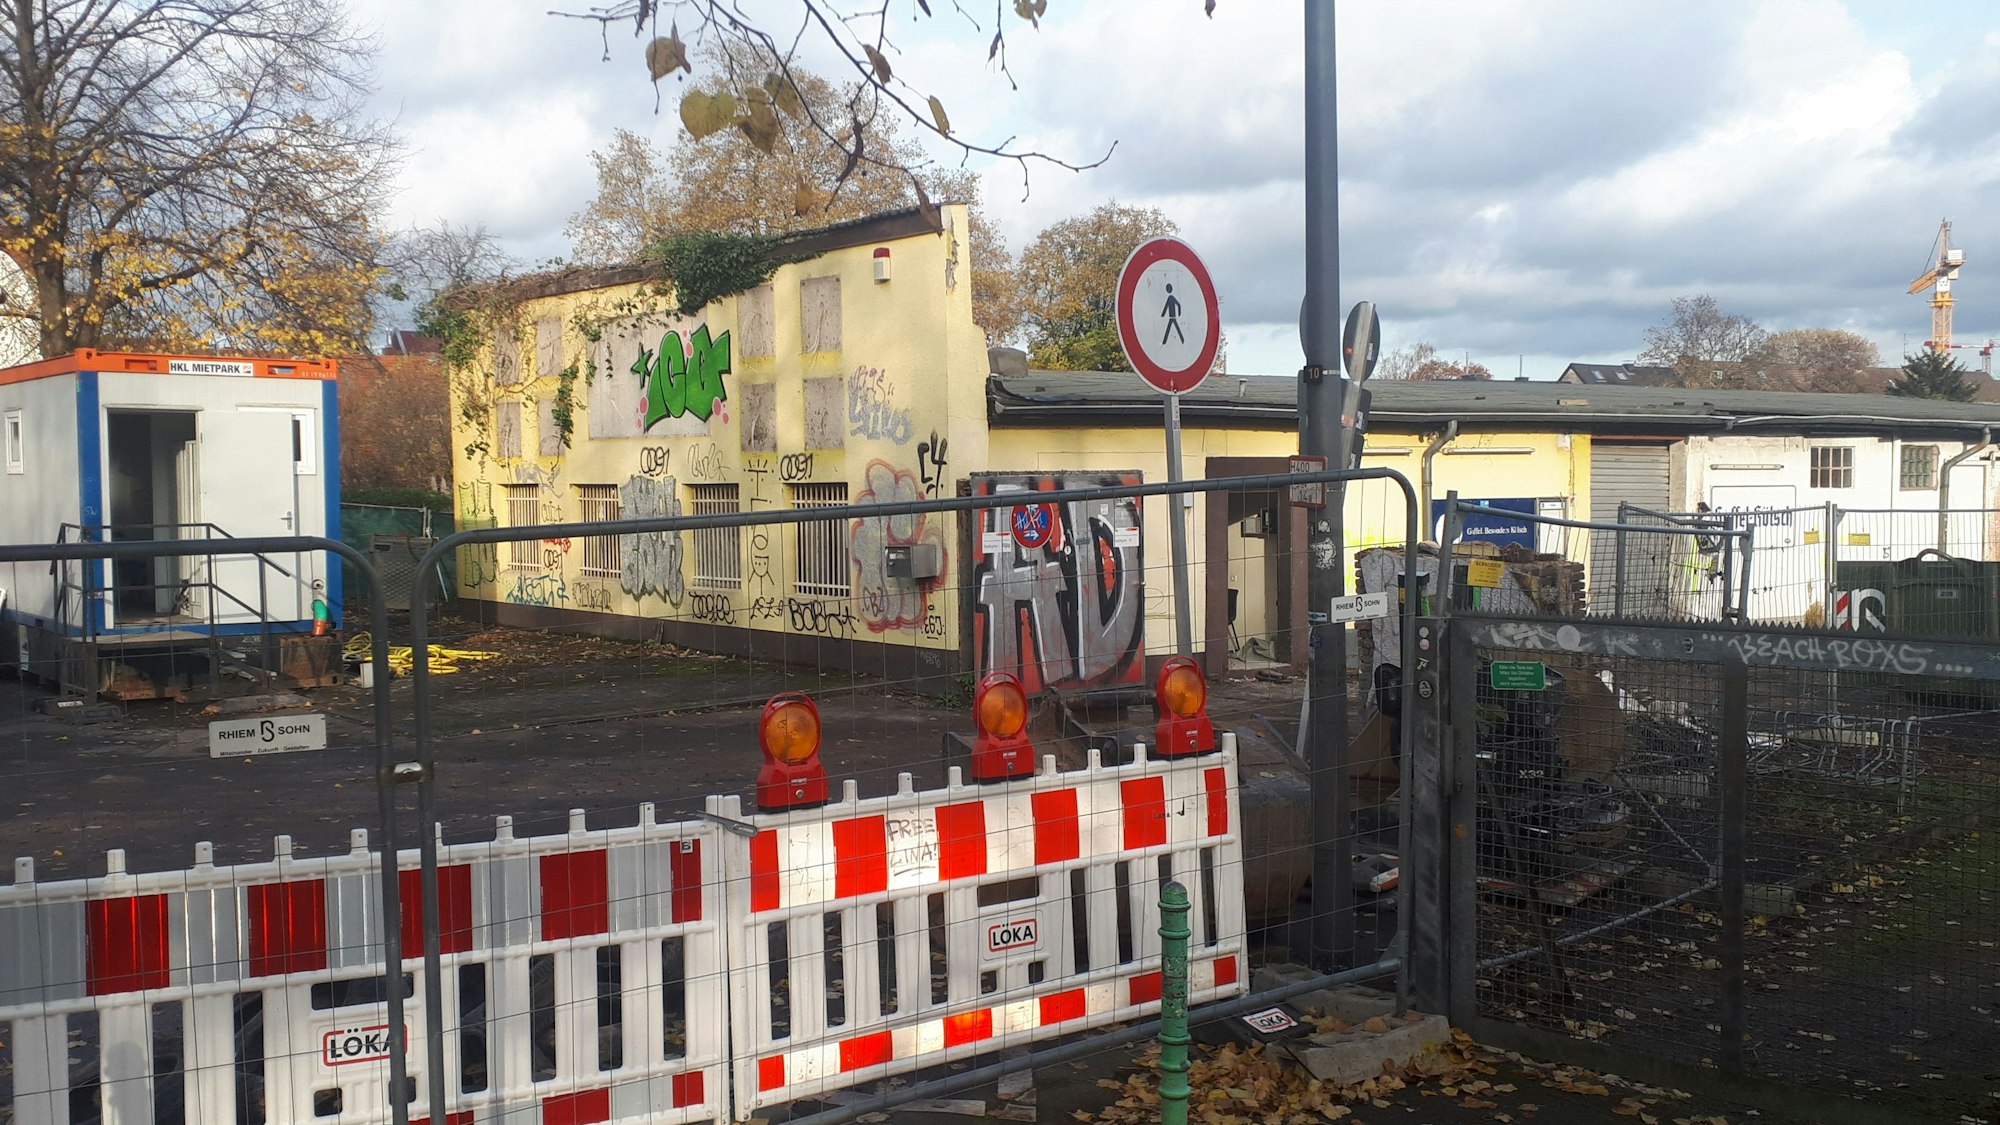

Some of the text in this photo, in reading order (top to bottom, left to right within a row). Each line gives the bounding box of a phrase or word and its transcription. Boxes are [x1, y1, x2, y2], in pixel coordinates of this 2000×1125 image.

[170, 362, 241, 374] HKL MIETPARK
[1308, 368, 1320, 380] 10
[1336, 599, 1380, 611] RHIEM SOHN
[218, 724, 311, 740] RHIEM SOHN
[886, 818, 935, 841] FREE
[992, 922, 1034, 947] LÖKA
